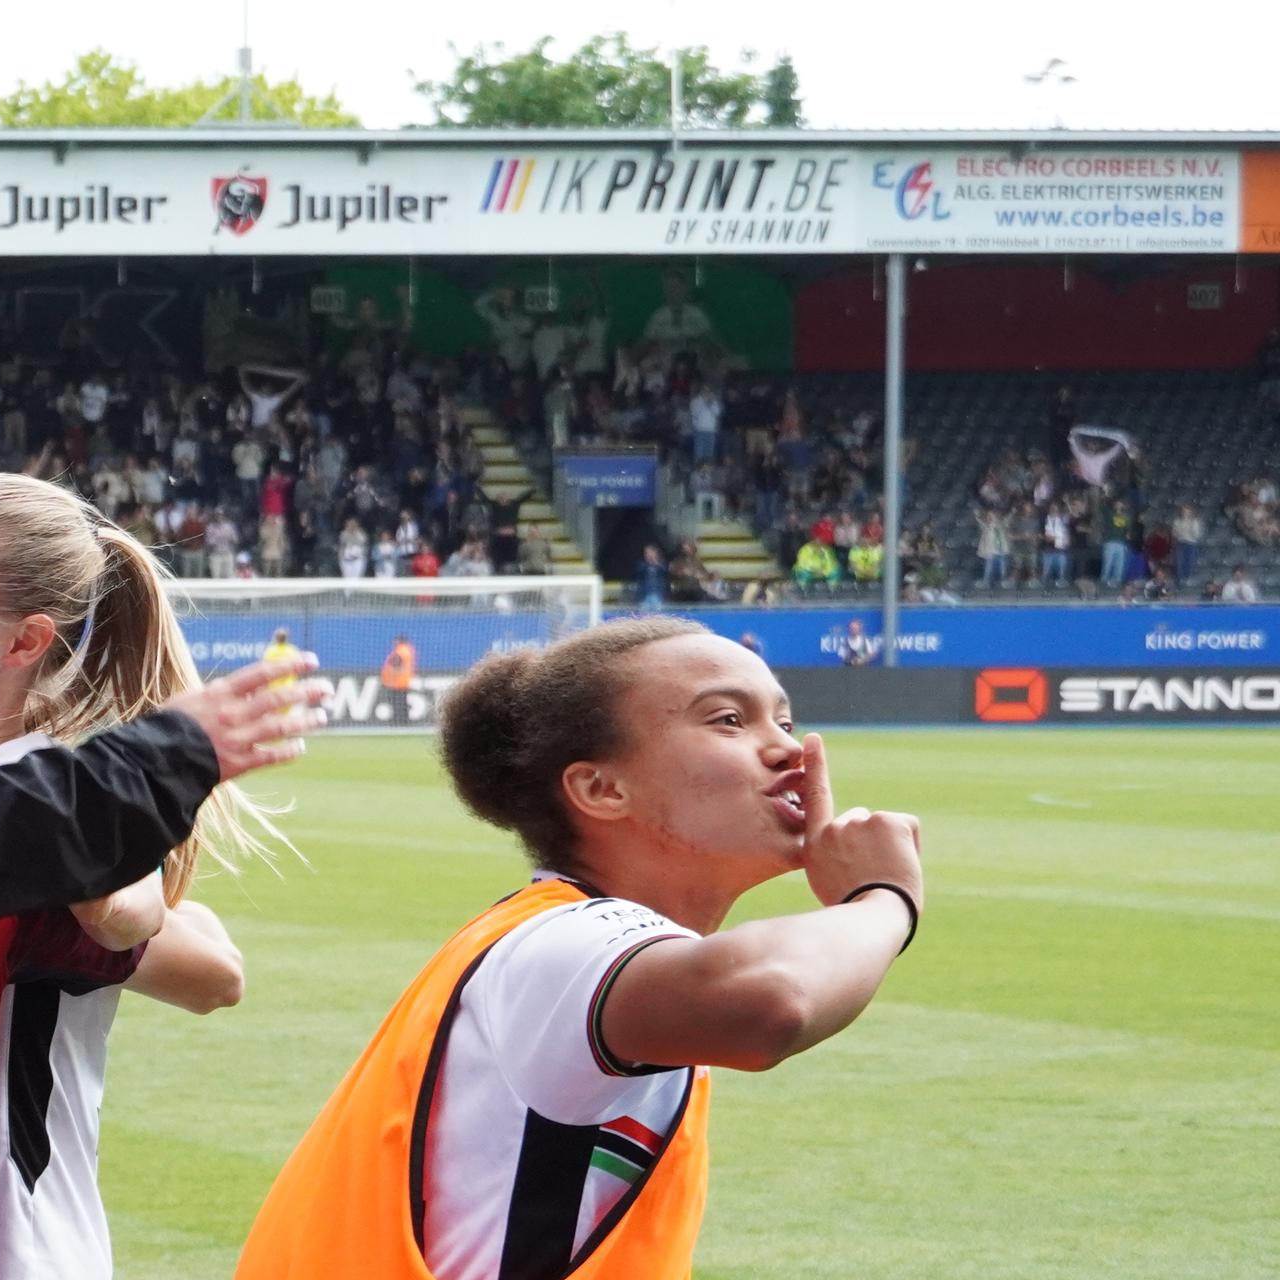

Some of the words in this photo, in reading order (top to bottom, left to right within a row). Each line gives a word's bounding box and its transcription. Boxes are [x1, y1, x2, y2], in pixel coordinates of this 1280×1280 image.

[956, 156, 1055, 178] ELECTRO
[1061, 156, 1176, 178] CORBEELS
[1180, 156, 1224, 178] N.V.
[953, 185, 995, 201] ALG.
[1001, 184, 1224, 201] ELEKTRICITEITSWERKEN
[277, 184, 449, 232] Jupiler
[994, 204, 1225, 227] www.corbeels.be
[664, 219, 697, 245] BY
[706, 219, 831, 245] SHANNON
[1146, 631, 1192, 651] KING
[1197, 631, 1265, 651] POWER
[1059, 677, 1280, 712] STANNO
